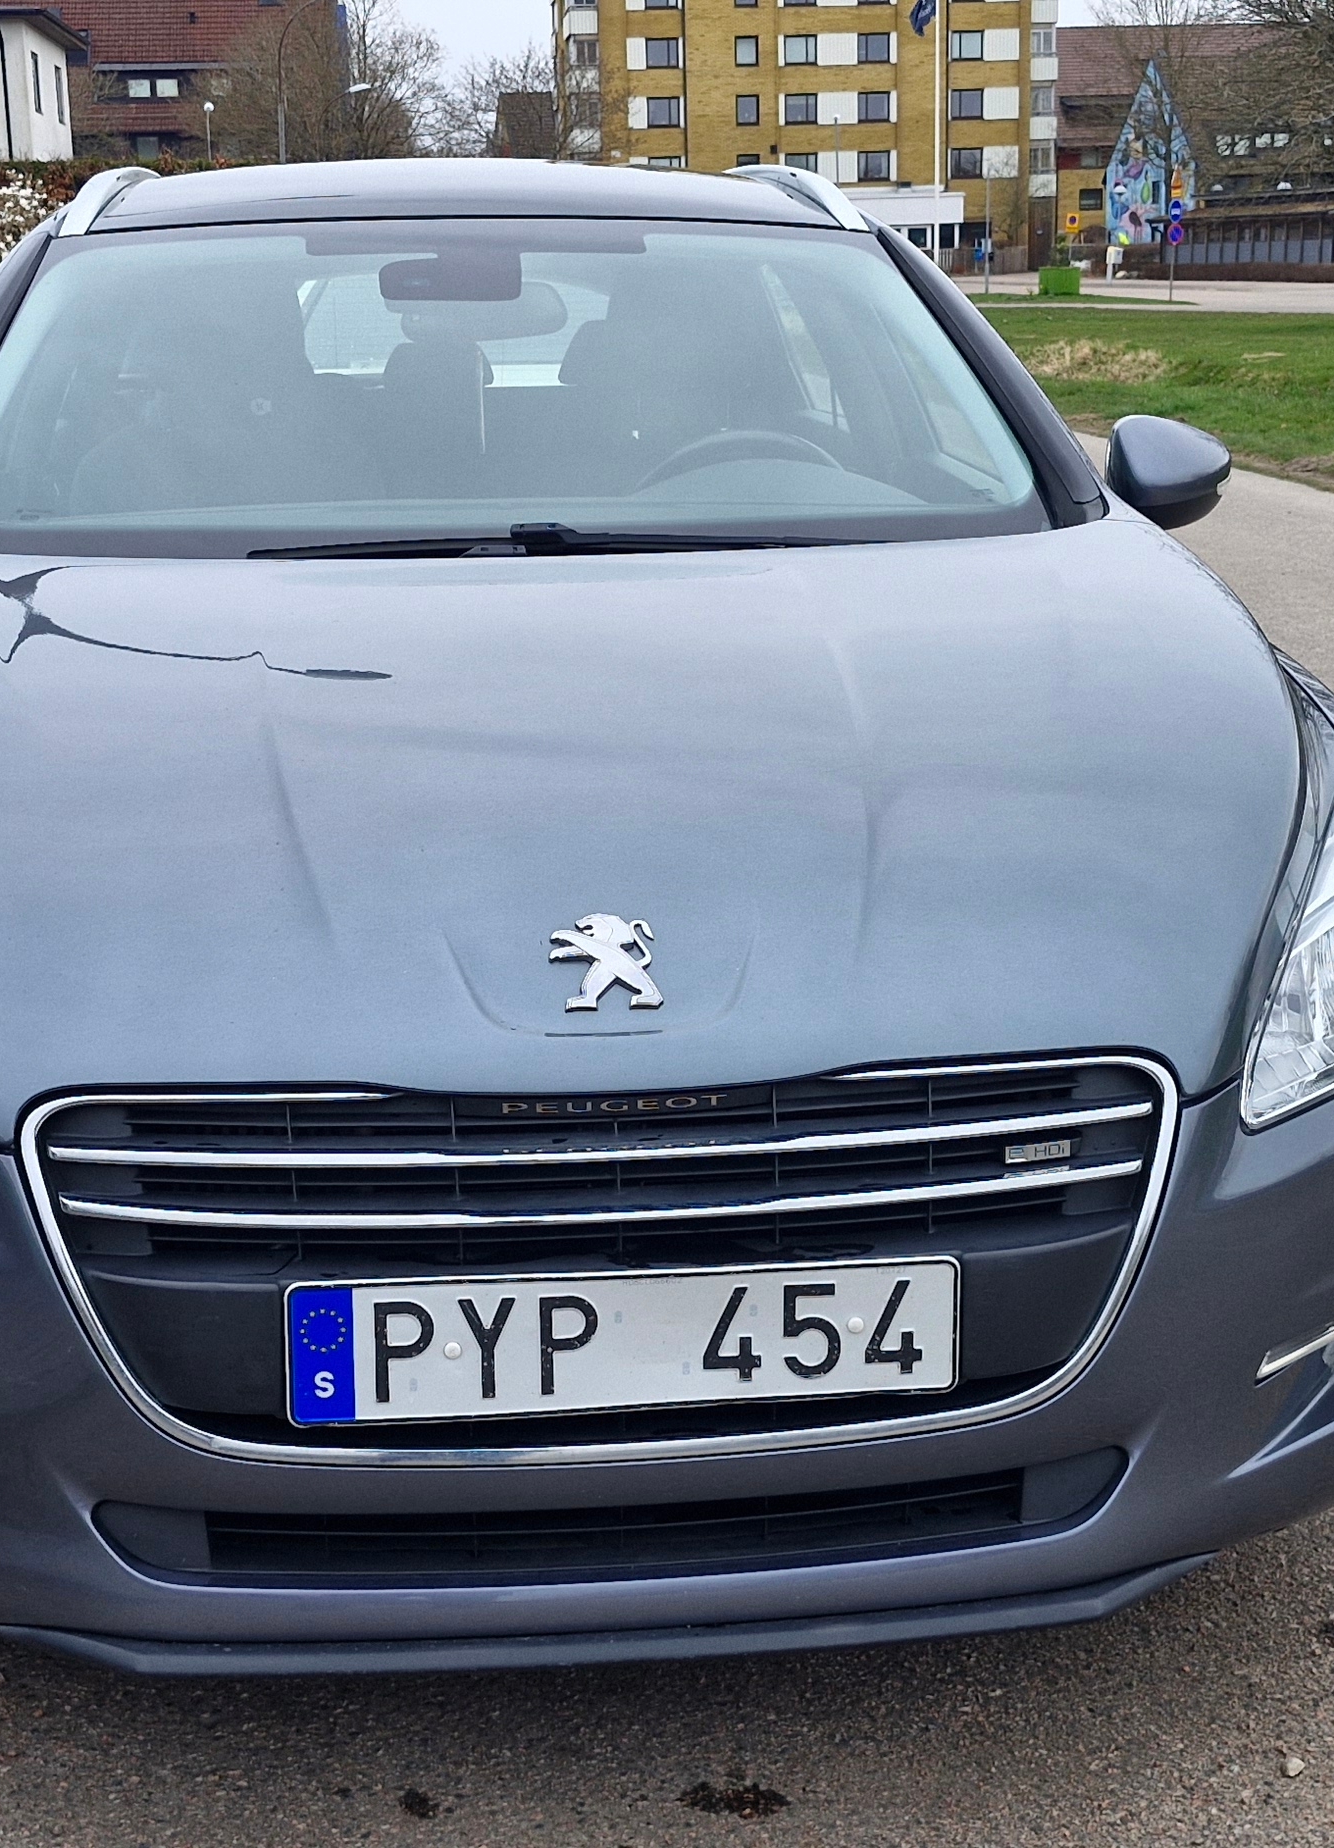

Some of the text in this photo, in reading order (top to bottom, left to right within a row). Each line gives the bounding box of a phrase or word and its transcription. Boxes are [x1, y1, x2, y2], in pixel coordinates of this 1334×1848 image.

[502, 1094, 728, 1114] PEUGEOT
[1034, 1144, 1065, 1157] HDi
[373, 1279, 923, 1403] PYP 454
[314, 1371, 335, 1398] S
